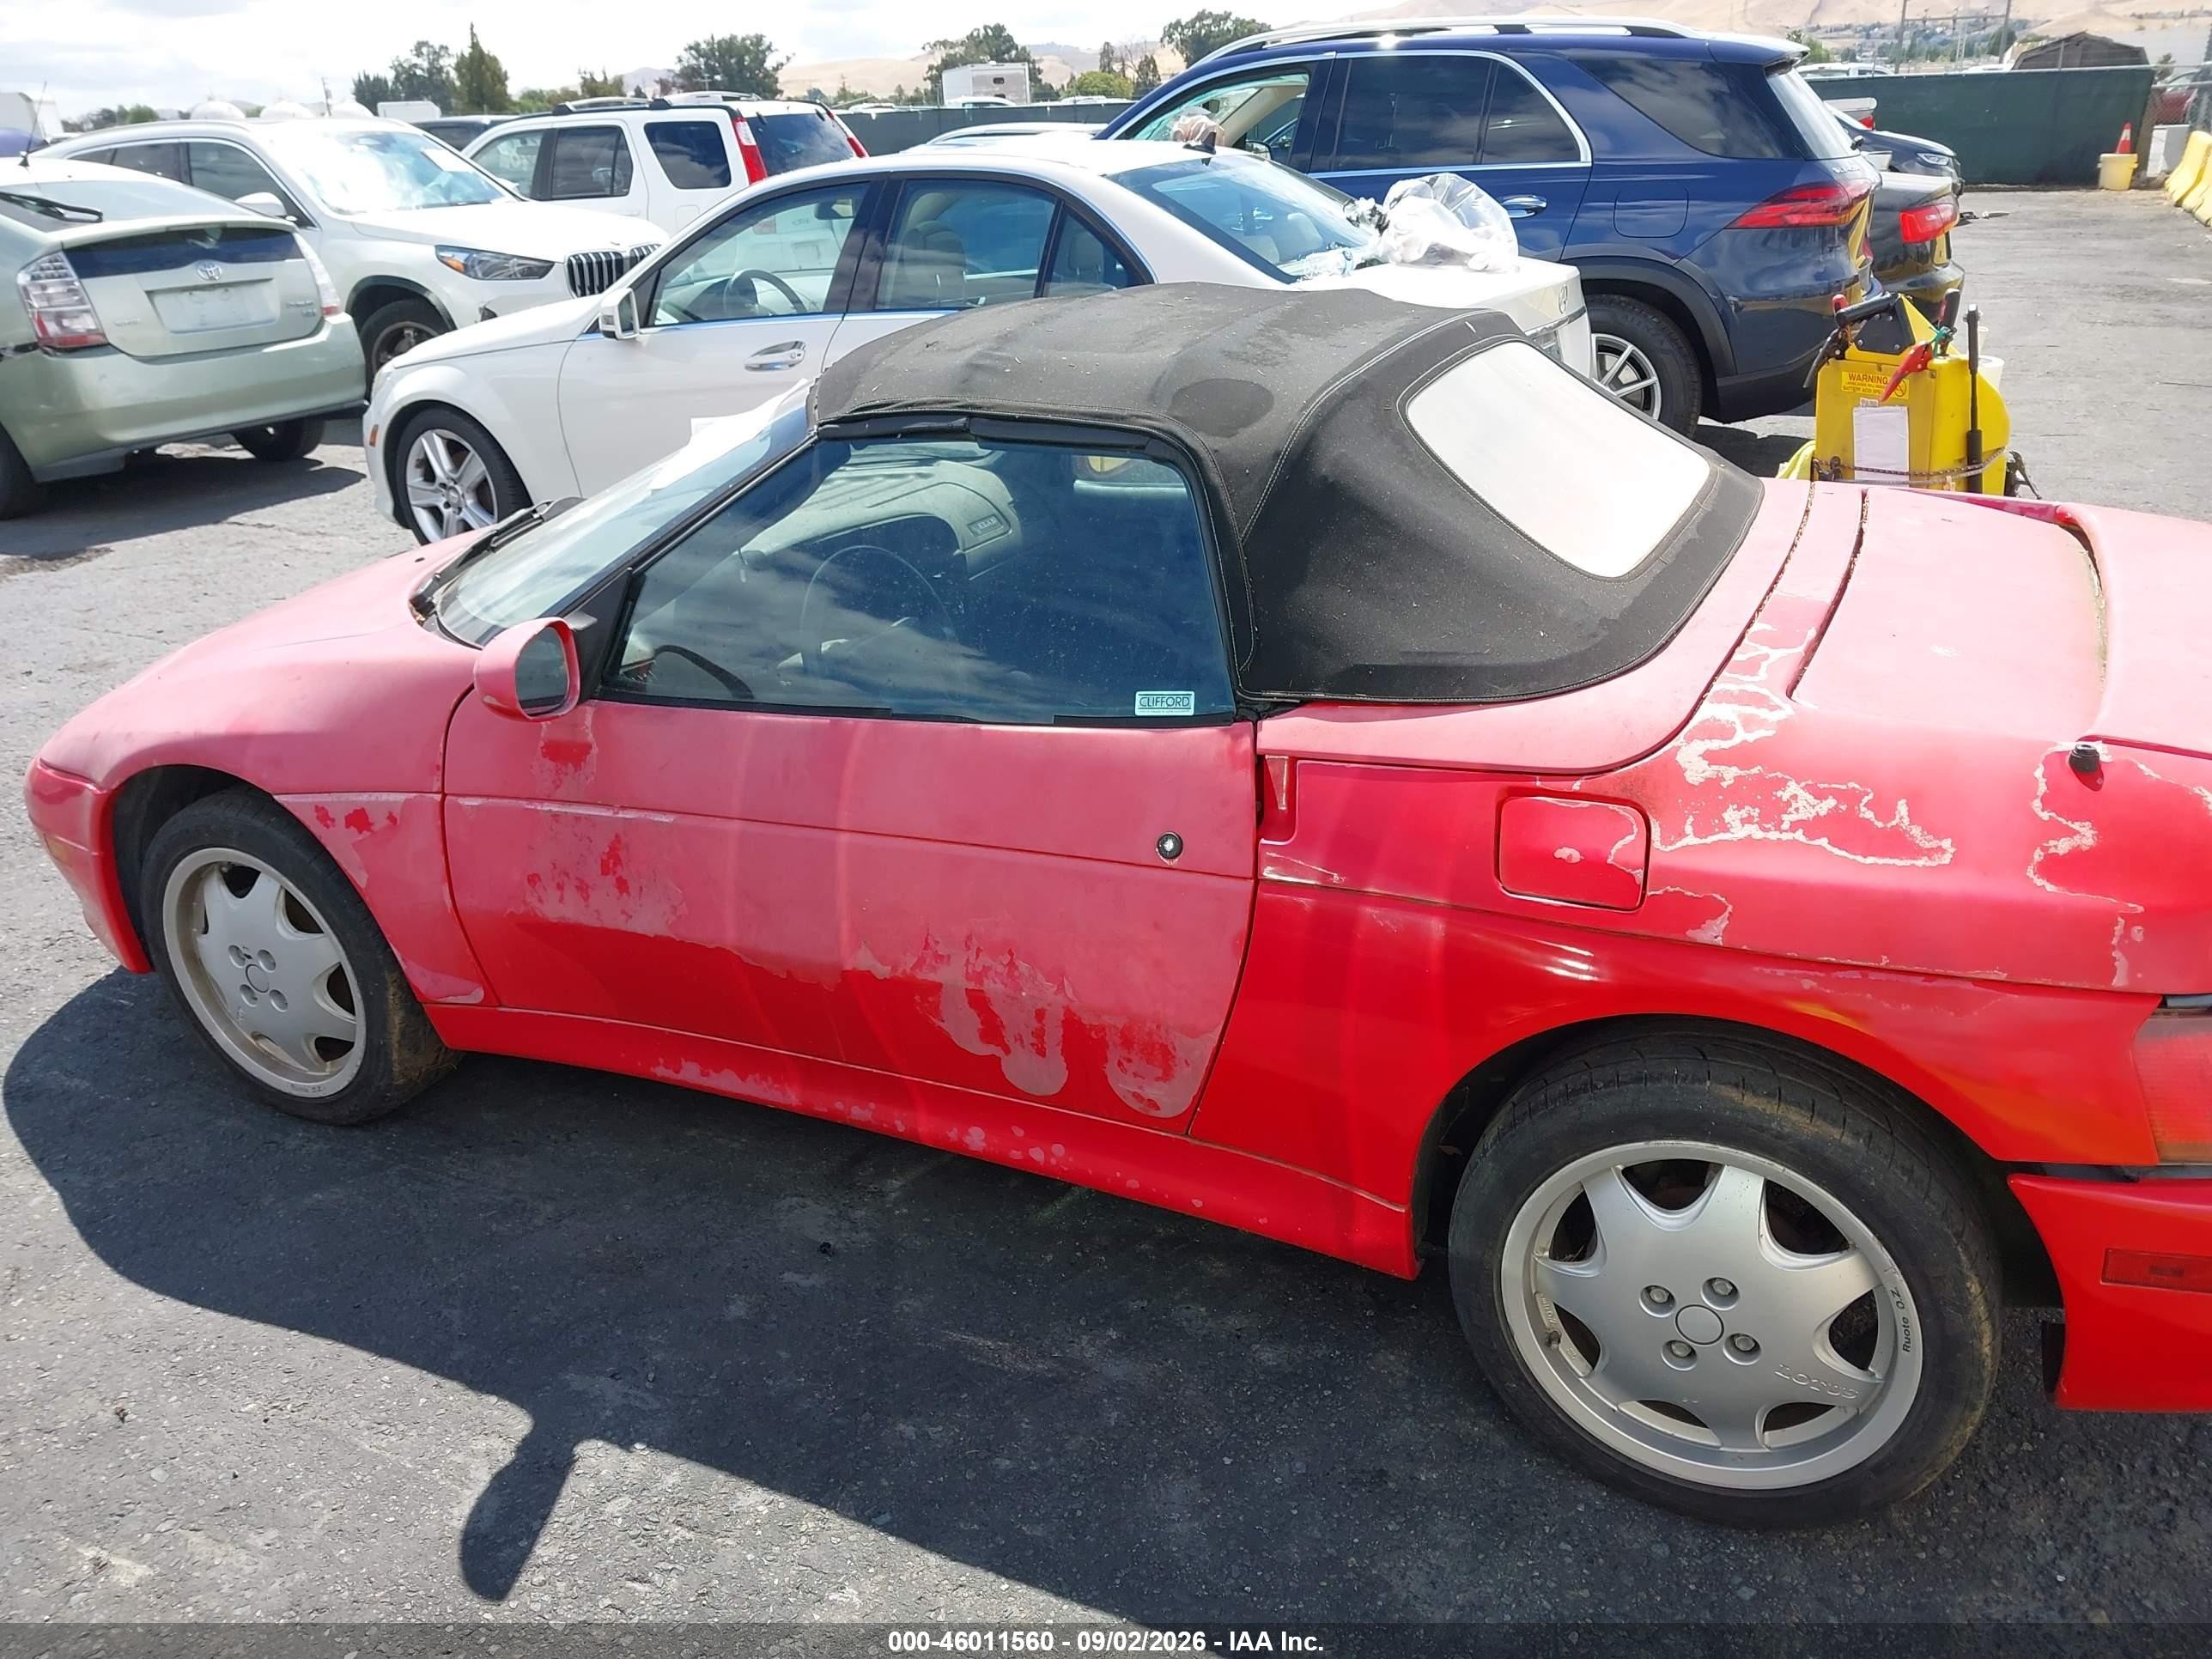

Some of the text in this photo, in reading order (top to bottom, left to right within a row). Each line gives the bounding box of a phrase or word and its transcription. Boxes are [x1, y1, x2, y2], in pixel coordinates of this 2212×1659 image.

[1848, 372, 1888, 385] WARNING
[1139, 696, 1190, 708] CLIFFORD
[1902, 1316, 1911, 1352] Ruote
[1773, 1363, 1859, 1400] LOTUS
